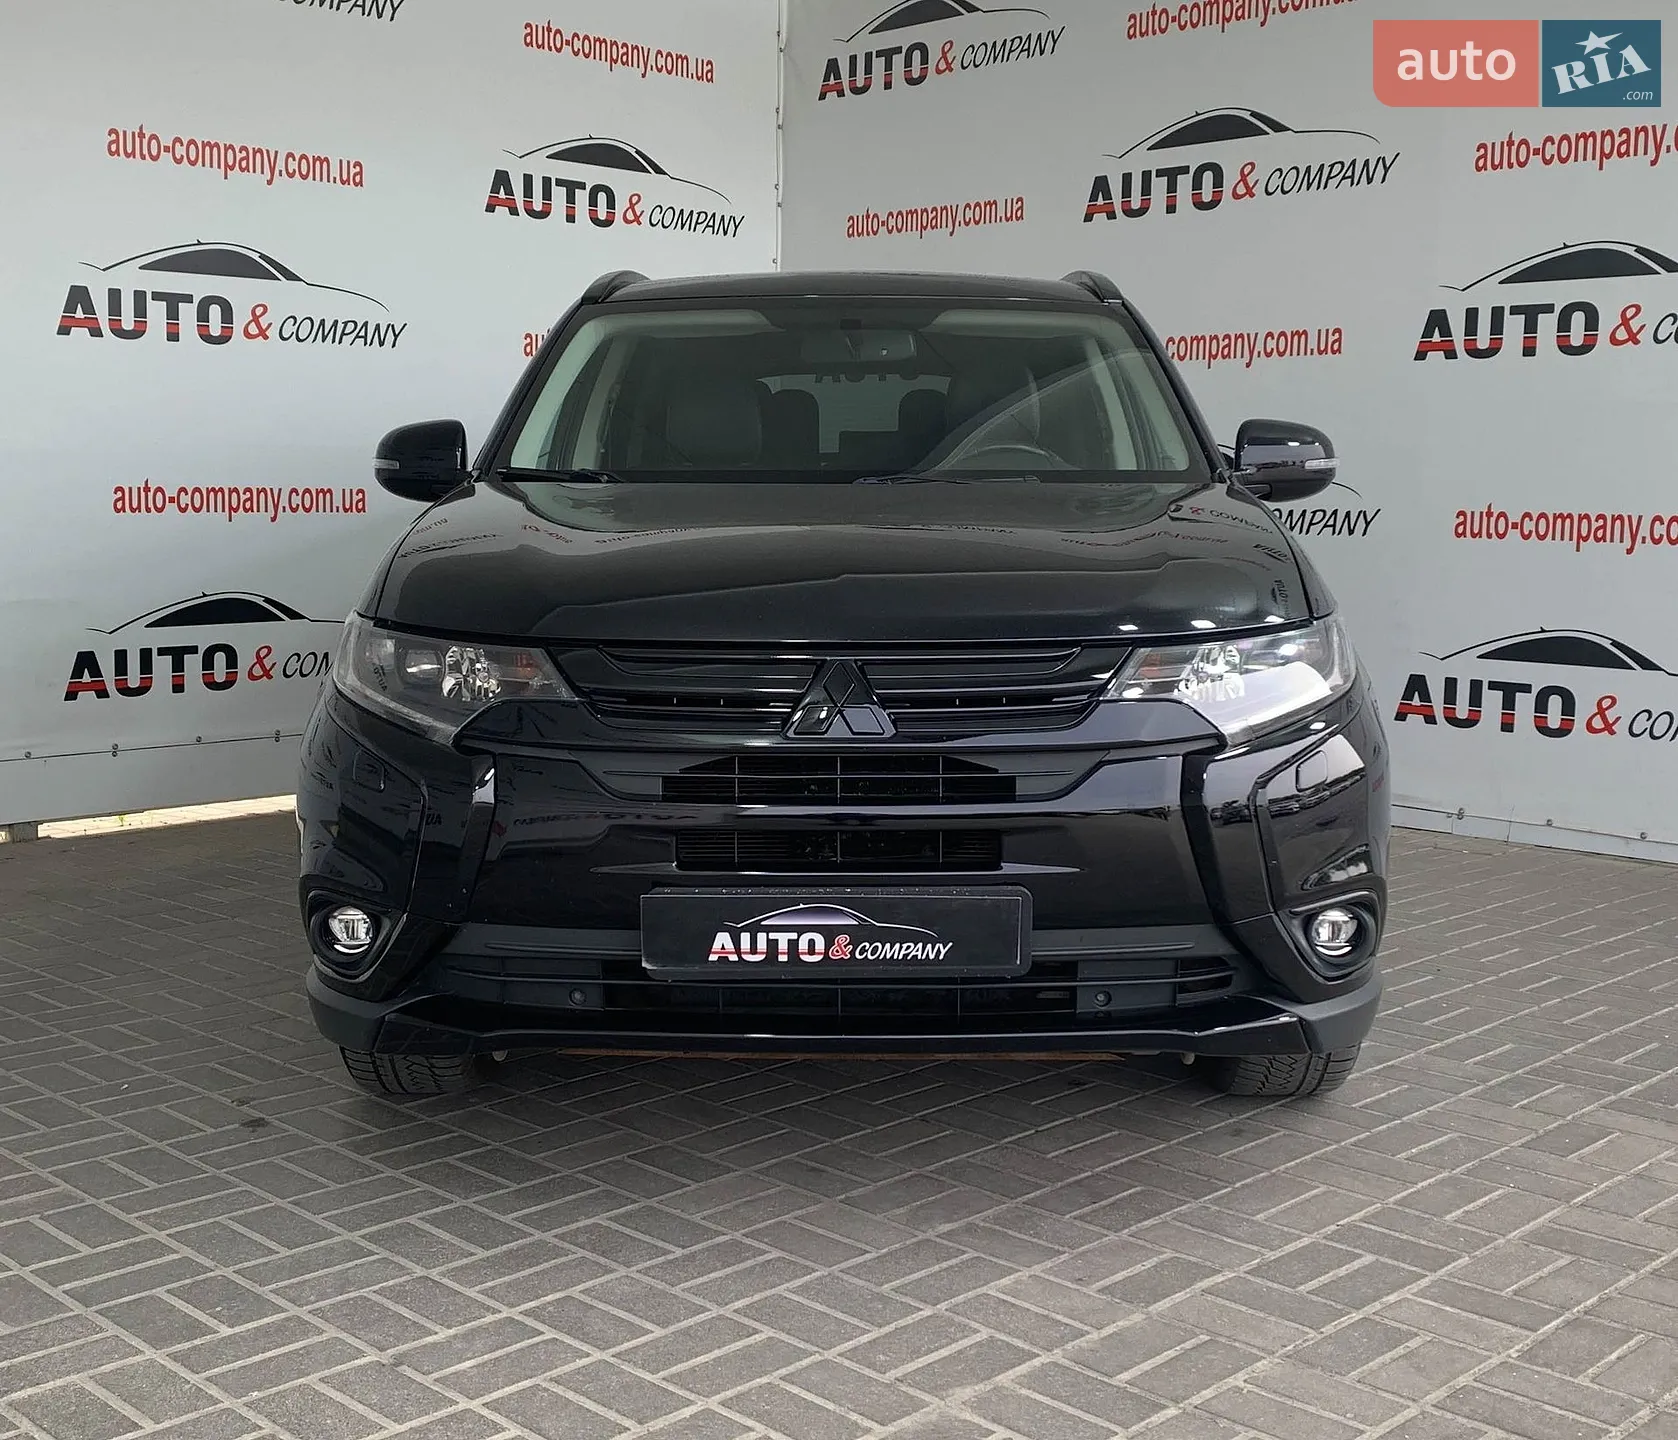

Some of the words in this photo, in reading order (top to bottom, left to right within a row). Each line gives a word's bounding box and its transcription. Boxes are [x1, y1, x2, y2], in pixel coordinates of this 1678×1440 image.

[524, 22, 713, 82] auto-company.com.ua
[818, 41, 929, 101] AUTO
[934, 41, 956, 75] &
[960, 26, 1066, 71] COMPANY
[107, 125, 364, 189] auto-company.com.ua
[1083, 162, 1224, 223] AUTO
[1231, 161, 1257, 200] &
[1264, 153, 1401, 197] COMPANY
[485, 168, 617, 228] AUTO
[622, 193, 643, 226] &
[648, 204, 745, 239] COMPANY
[846, 195, 1025, 240] auto-company.com.ua
[56, 284, 235, 346] AUTO
[242, 302, 272, 342] &
[278, 314, 408, 349] COMPANY
[1413, 300, 1600, 362] AUTO
[1608, 303, 1647, 346] &
[1652, 312, 1678, 345] C
[112, 478, 367, 523] auto-company.com.ua
[63, 642, 239, 702] AUTO
[247, 645, 277, 681] &
[1394, 673, 1576, 738] AUTO
[1585, 694, 1622, 736] &
[1628, 708, 1678, 742] CO
[708, 932, 825, 962] AUTO
[828, 935, 852, 961] &
[854, 942, 953, 961] COMPANY
